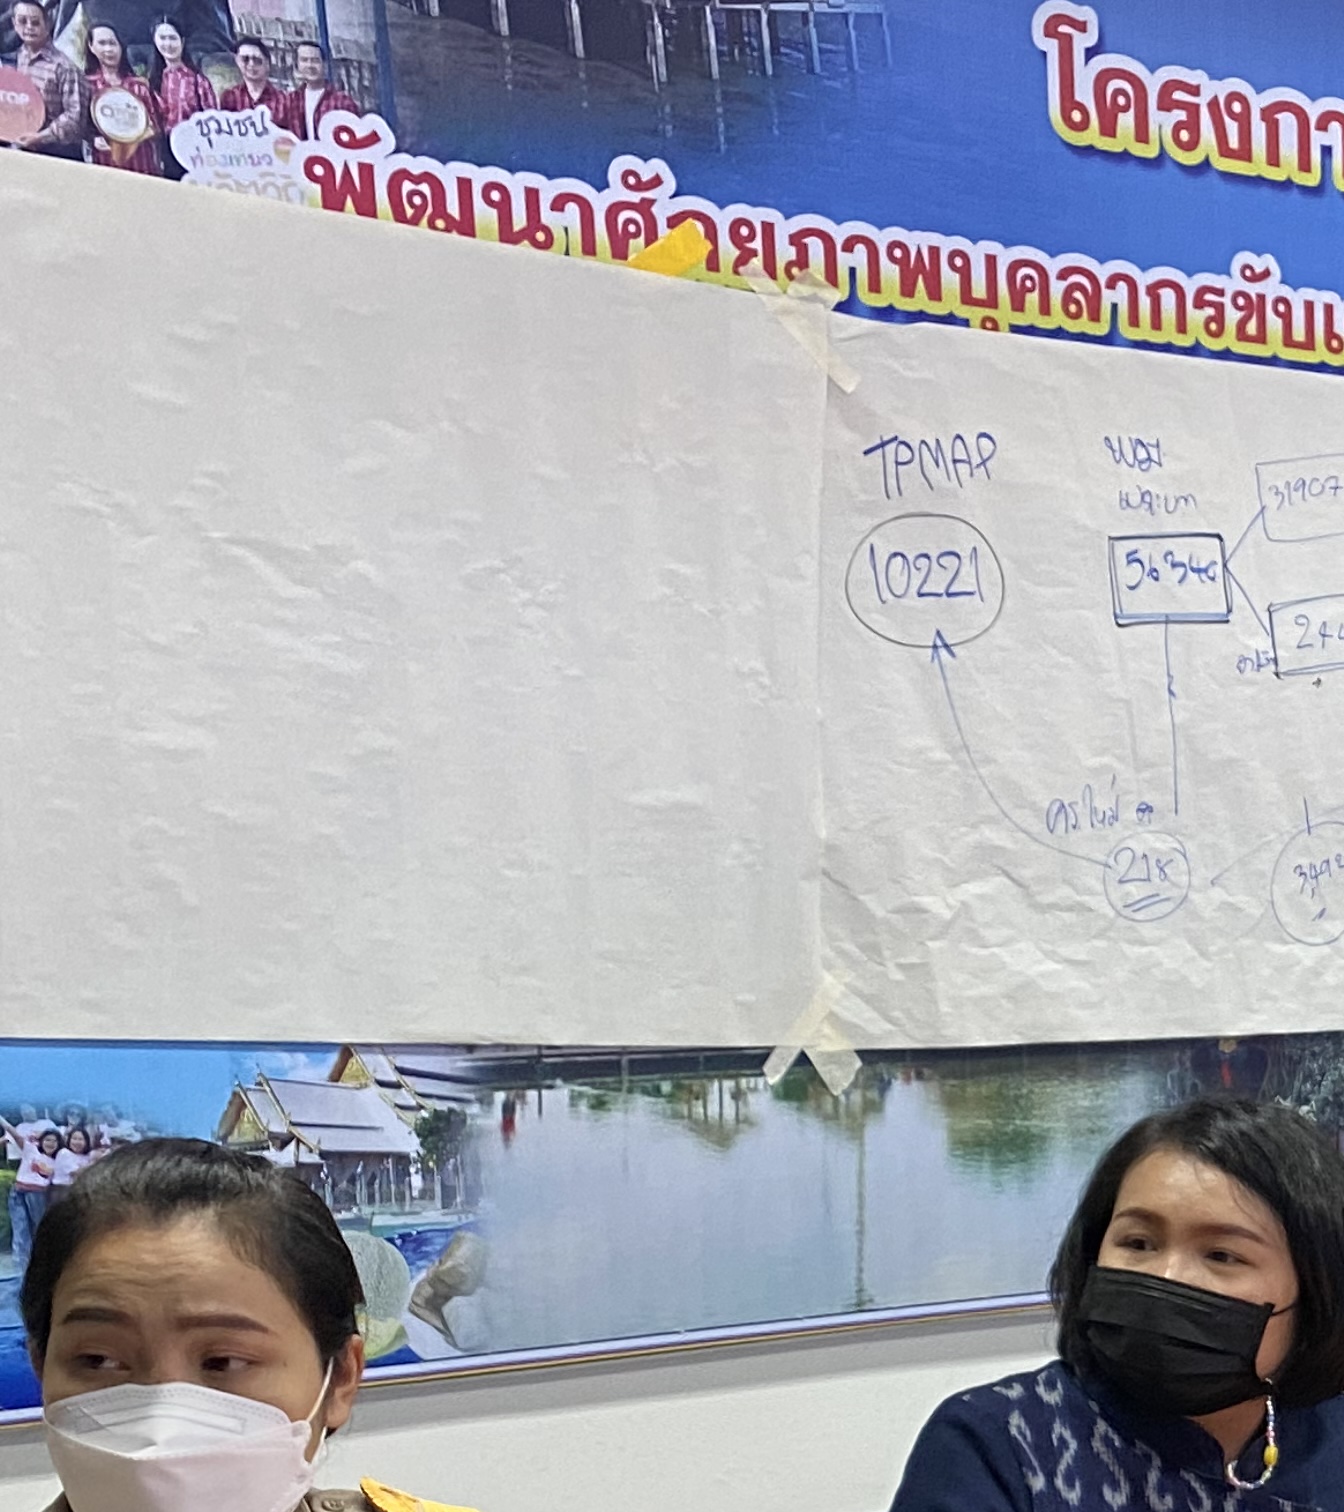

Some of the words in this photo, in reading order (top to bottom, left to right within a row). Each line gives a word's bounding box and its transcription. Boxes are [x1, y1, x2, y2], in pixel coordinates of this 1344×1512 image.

[196, 111, 269, 148] ชุมชน
[863, 432, 998, 500] TPMAP
[868, 542, 986, 604] 10221
